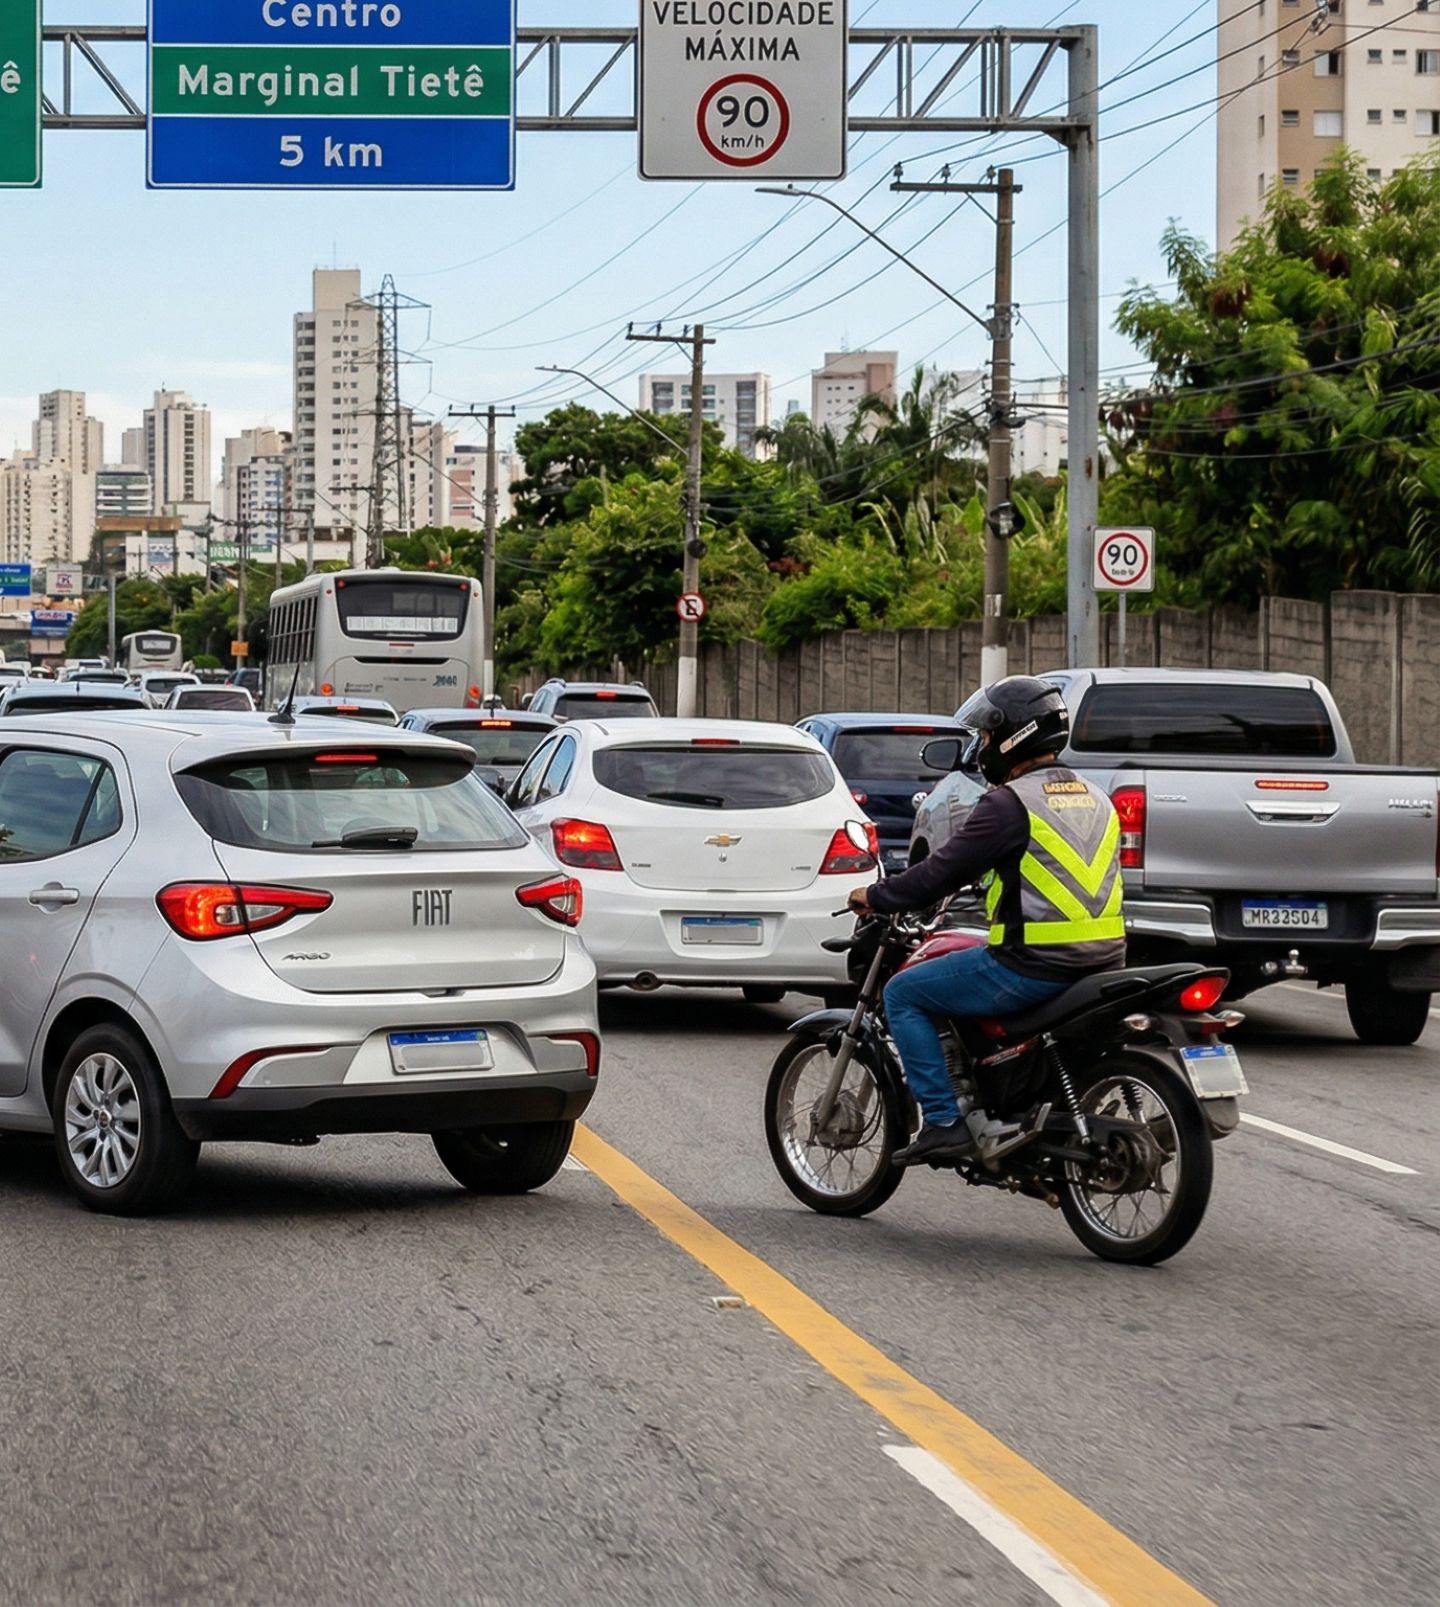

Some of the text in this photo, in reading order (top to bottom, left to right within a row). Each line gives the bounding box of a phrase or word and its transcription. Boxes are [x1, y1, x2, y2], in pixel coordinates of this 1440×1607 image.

[261, 0, 402, 28] Centro
[652, 1, 835, 26] VELOCIDADE
[685, 29, 800, 61] MÁXIMA
[178, 64, 484, 107] Marginal Tietê
[716, 95, 770, 128] 90
[279, 135, 383, 167] 5 km
[720, 134, 765, 149] km/h
[1107, 543, 1138, 566] 90
[412, 889, 453, 926] FIAT
